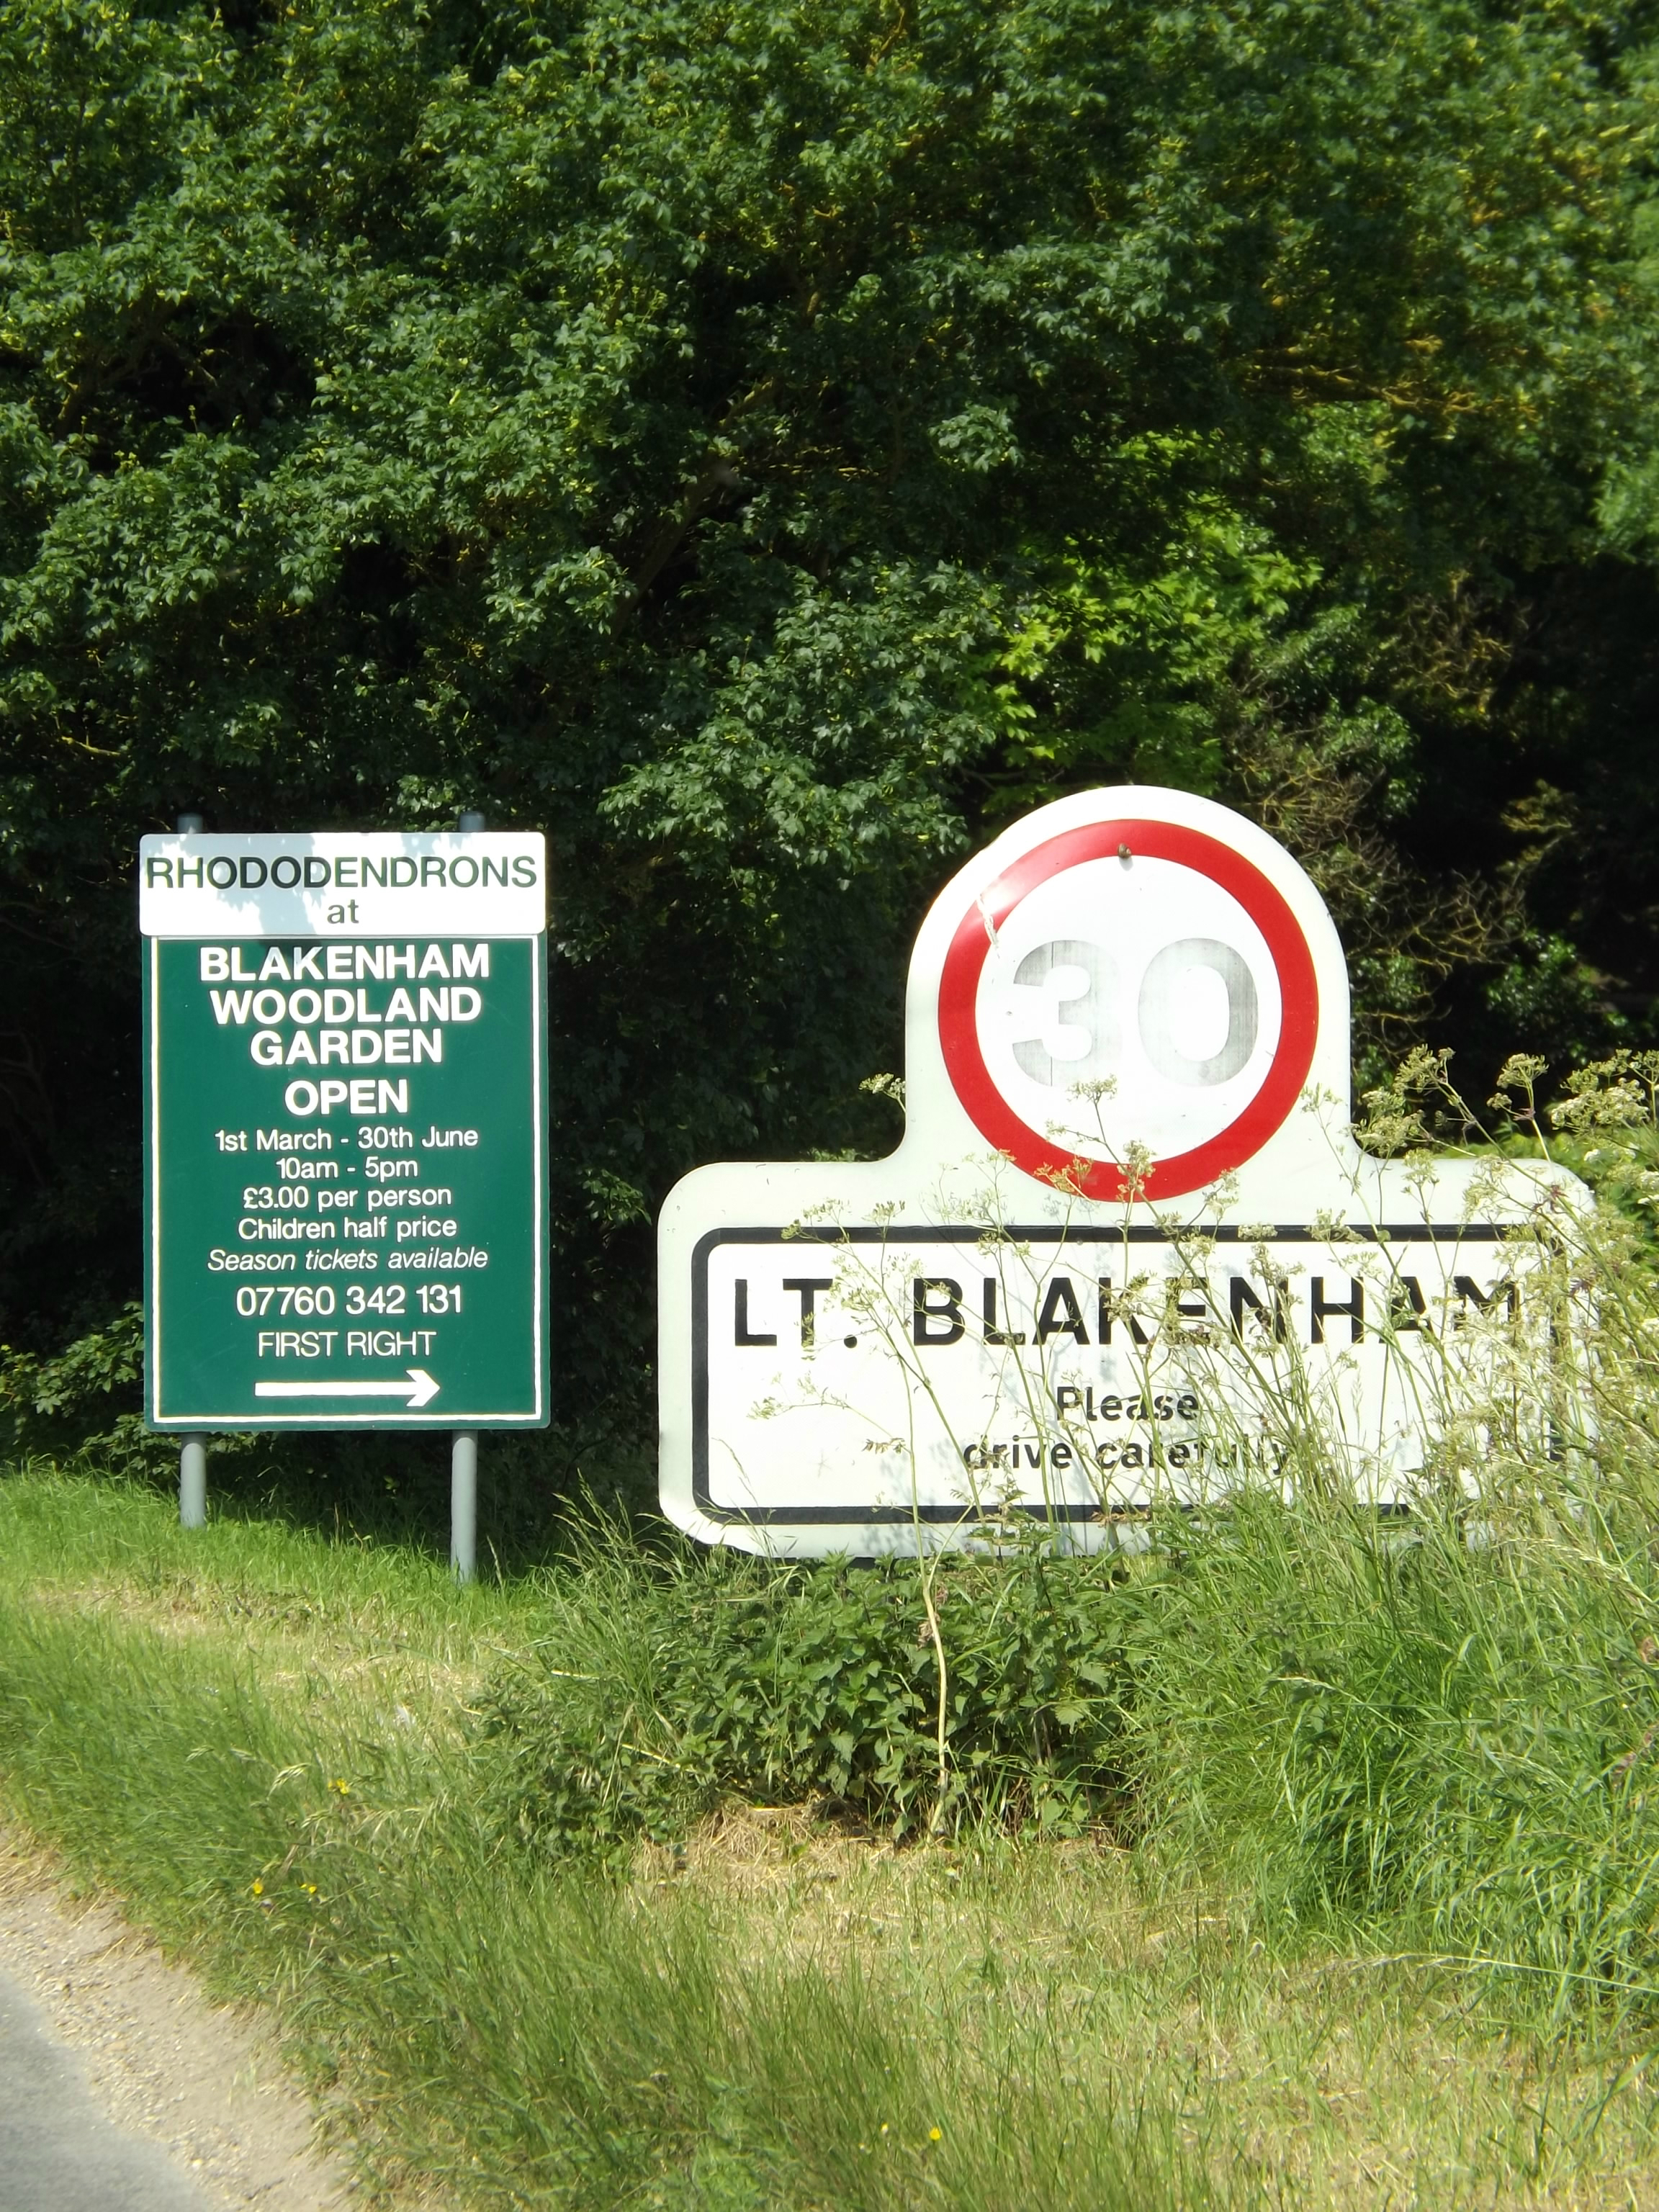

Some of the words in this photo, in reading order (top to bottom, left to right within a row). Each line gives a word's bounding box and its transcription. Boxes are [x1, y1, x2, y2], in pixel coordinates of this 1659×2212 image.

[146, 855, 538, 889] RHODODENDRONS
[326, 899, 360, 925] at
[199, 942, 490, 982] BLAKENHAM
[208, 985, 482, 1025] WOODLAND
[1012, 938, 1259, 1087] 30
[249, 1027, 443, 1066] GARDEN
[284, 1078, 408, 1116] OPEN
[214, 1128, 248, 1152] 1st
[256, 1127, 332, 1151] March
[357, 1125, 413, 1149] 30th
[421, 1125, 479, 1148] June
[275, 1156, 338, 1179] 10am
[364, 1155, 418, 1183] 5pm
[242, 1184, 310, 1210] £3.00
[317, 1189, 359, 1213] per
[367, 1187, 452, 1213] person
[237, 1217, 336, 1240] Children
[343, 1215, 388, 1238] half
[396, 1214, 457, 1243] price
[207, 1248, 296, 1271] Season
[305, 1247, 378, 1270] tickets
[387, 1245, 488, 1269] available
[235, 1285, 336, 1316] 07760
[345, 1283, 406, 1315] 342
[415, 1283, 461, 1314] 131
[734, 1278, 858, 1349] LT.
[913, 1276, 1521, 1345] BLAKENHAM
[257, 1330, 339, 1357] FIRST
[346, 1329, 437, 1357] RIGHT
[1056, 1386, 1200, 1421] Please
[963, 1434, 1073, 1469] drive
